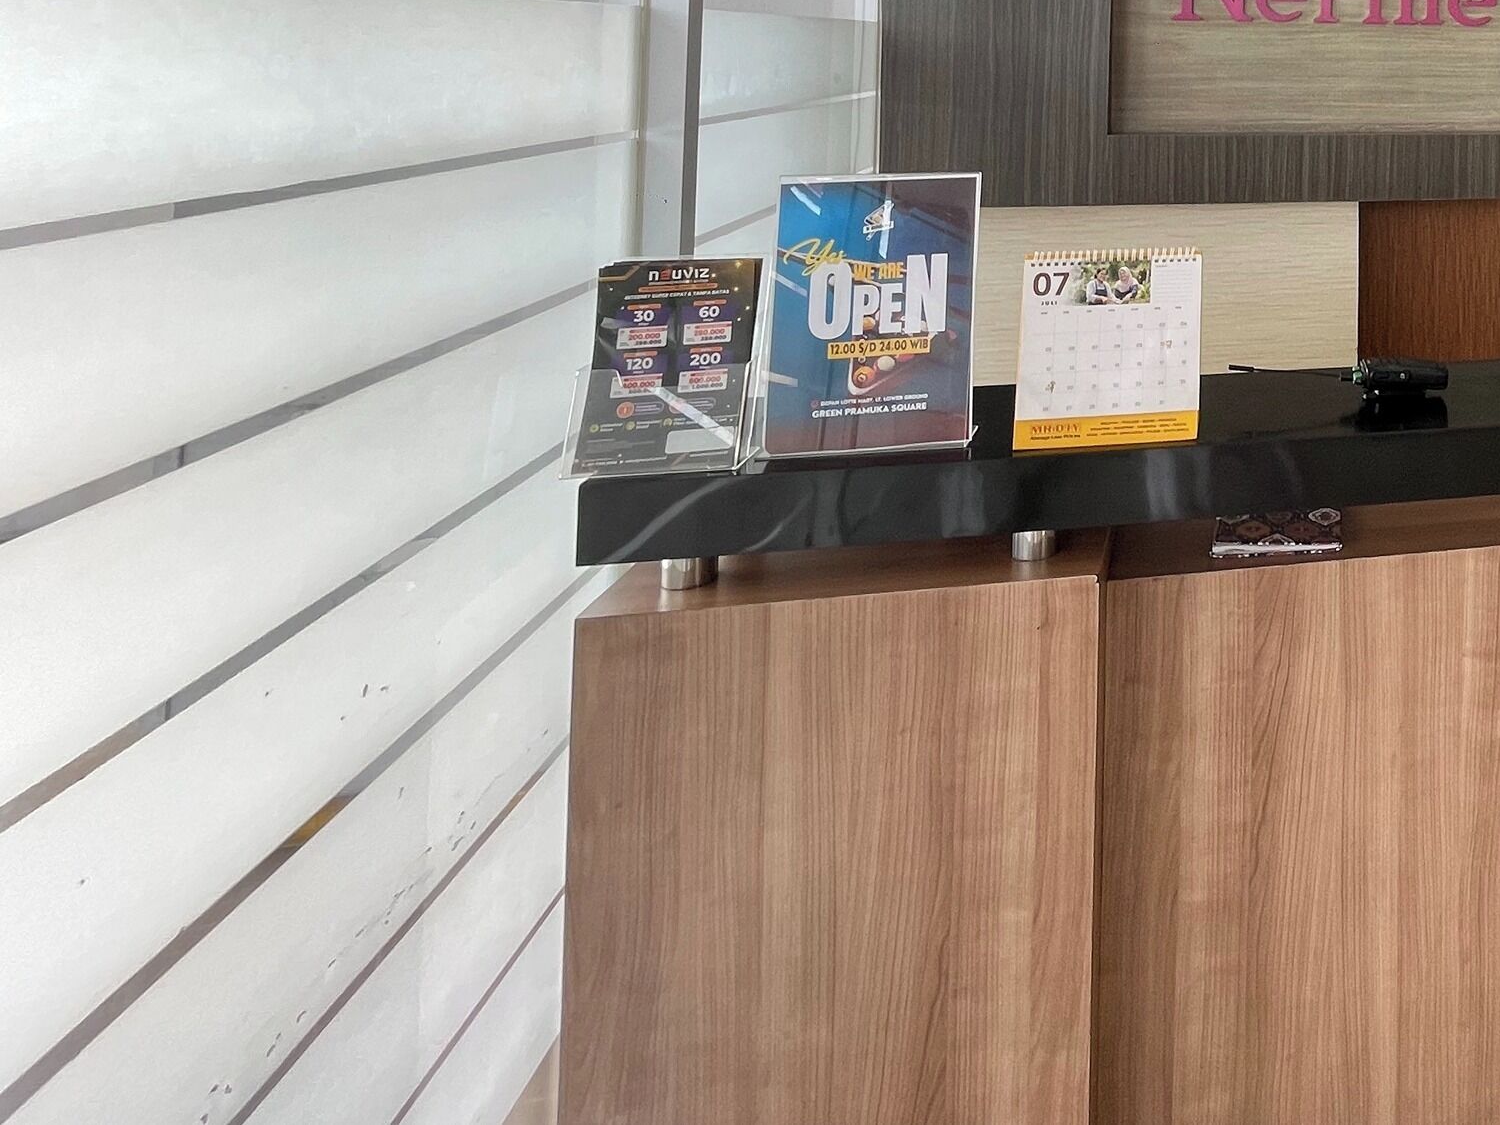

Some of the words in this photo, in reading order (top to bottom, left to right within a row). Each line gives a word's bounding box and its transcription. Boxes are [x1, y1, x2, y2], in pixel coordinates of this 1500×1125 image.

[853, 263, 876, 280] WE
[878, 262, 904, 279] ARE
[1032, 272, 1070, 296] 07
[808, 253, 949, 340] OPEN
[633, 309, 655, 323] 30
[699, 306, 720, 318] 60
[830, 343, 856, 355] 12.00
[858, 341, 876, 356] S/D
[879, 340, 907, 352] 24.00
[910, 338, 928, 350] WIB
[626, 357, 653, 370] 120
[689, 352, 721, 365] 200
[812, 408, 843, 419] GREEN
[844, 404, 890, 416] PRAMUKA
[891, 402, 927, 412] SQUARE
